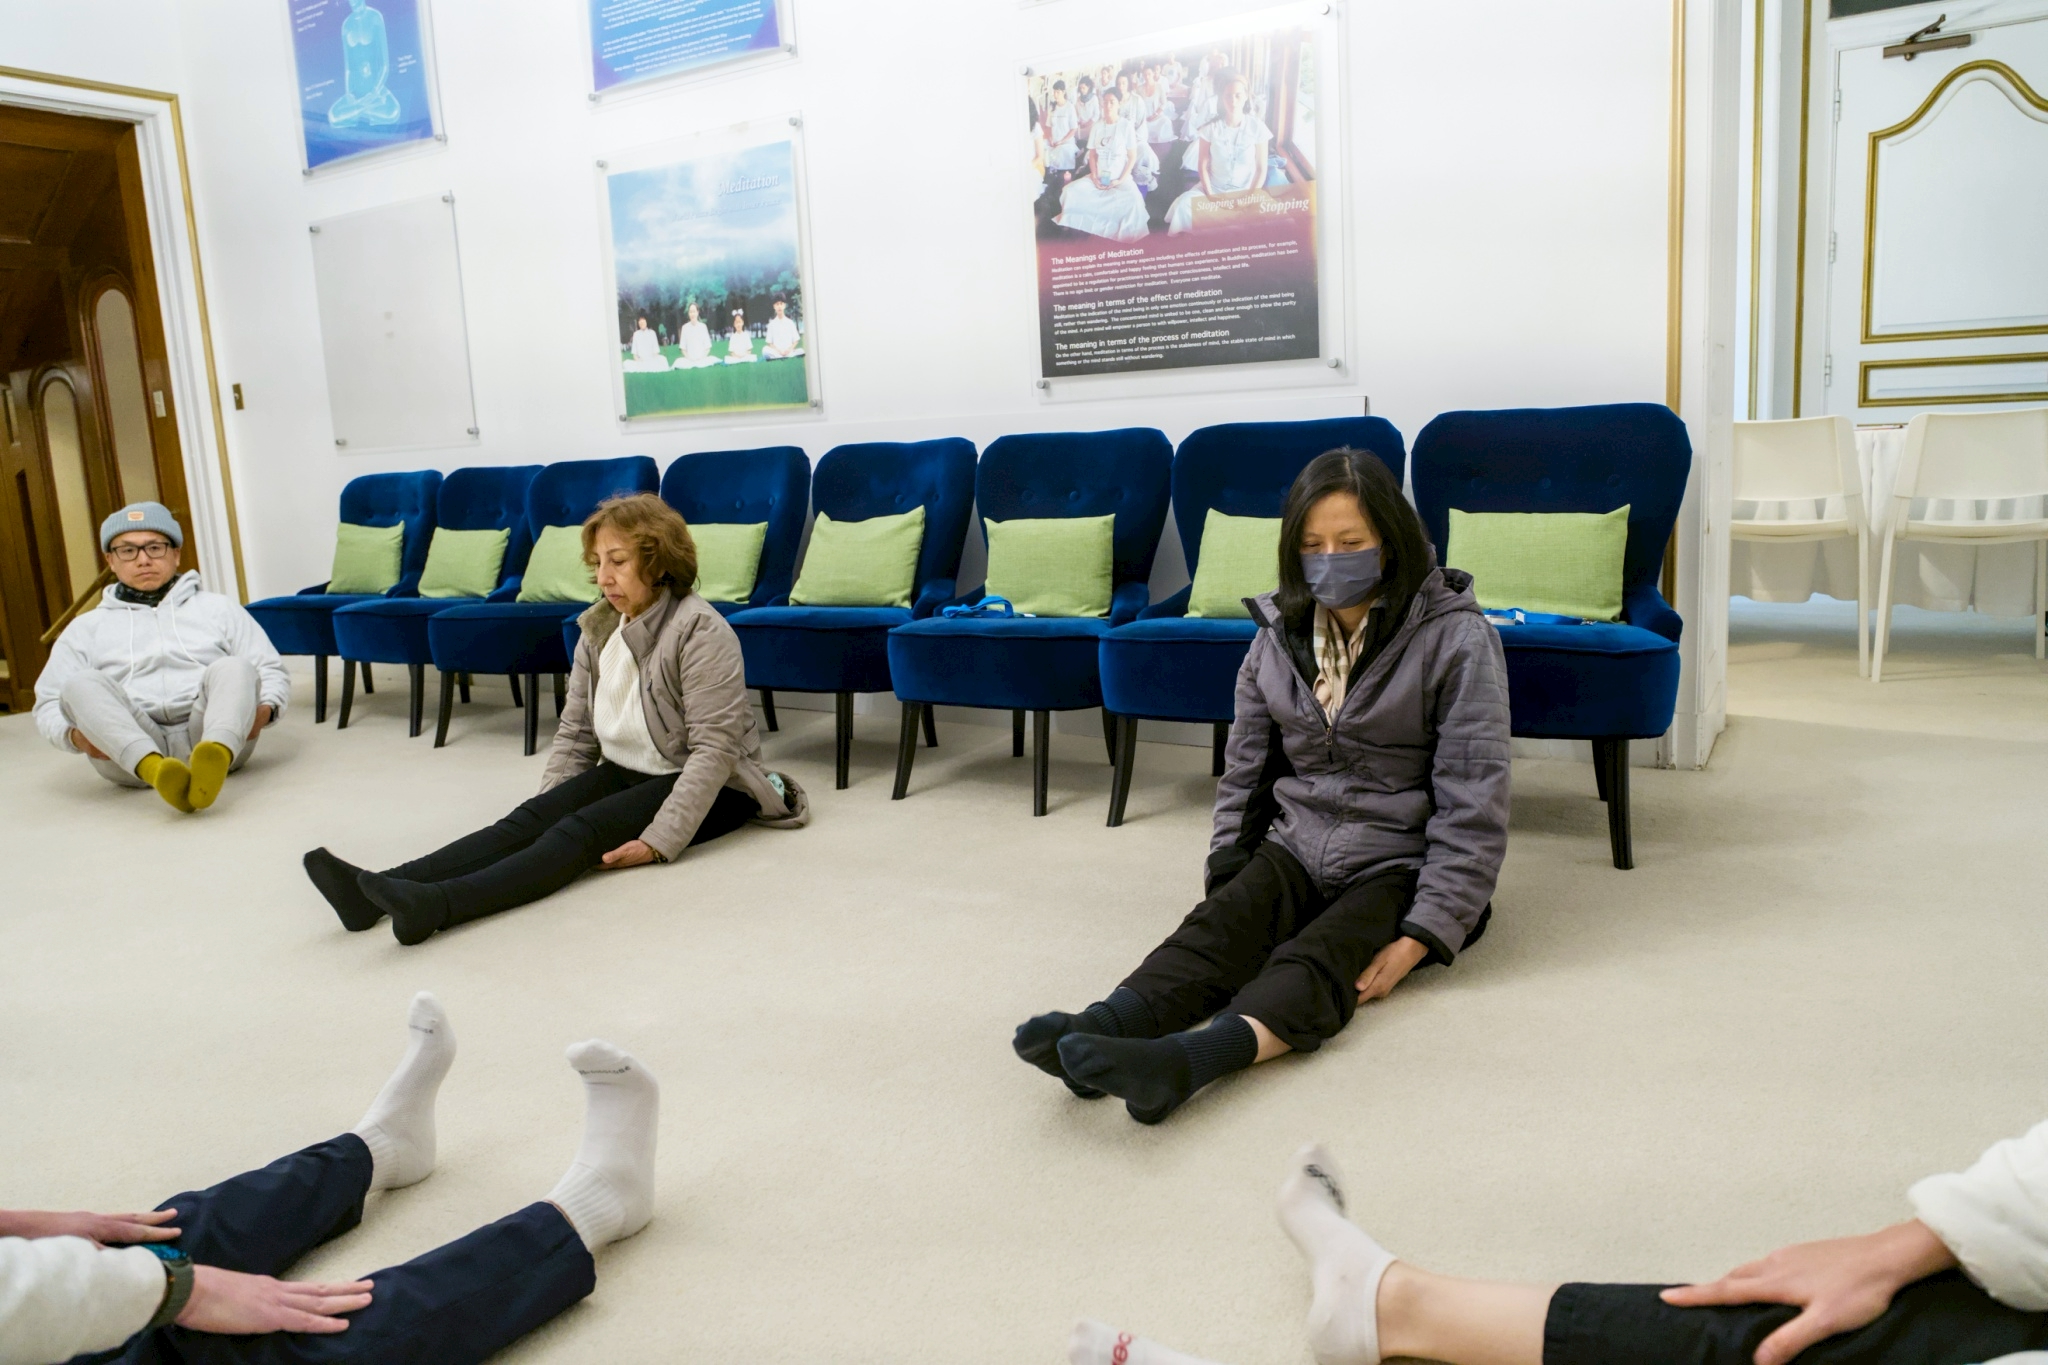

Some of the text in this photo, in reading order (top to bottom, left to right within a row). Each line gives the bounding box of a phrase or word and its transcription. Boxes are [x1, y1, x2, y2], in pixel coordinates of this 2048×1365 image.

[718, 175, 780, 197] Meditation
[1196, 198, 1236, 213] Stopping
[1259, 197, 1310, 215] Stopping
[1065, 254, 1097, 265] Meanings
[1107, 248, 1144, 258] Meditation
[1068, 302, 1096, 312] meaning
[1150, 293, 1172, 302] effect
[1184, 288, 1223, 299] meditation
[1069, 341, 1098, 351] meaning
[1152, 335, 1179, 343] process
[1191, 329, 1230, 339] meditation
